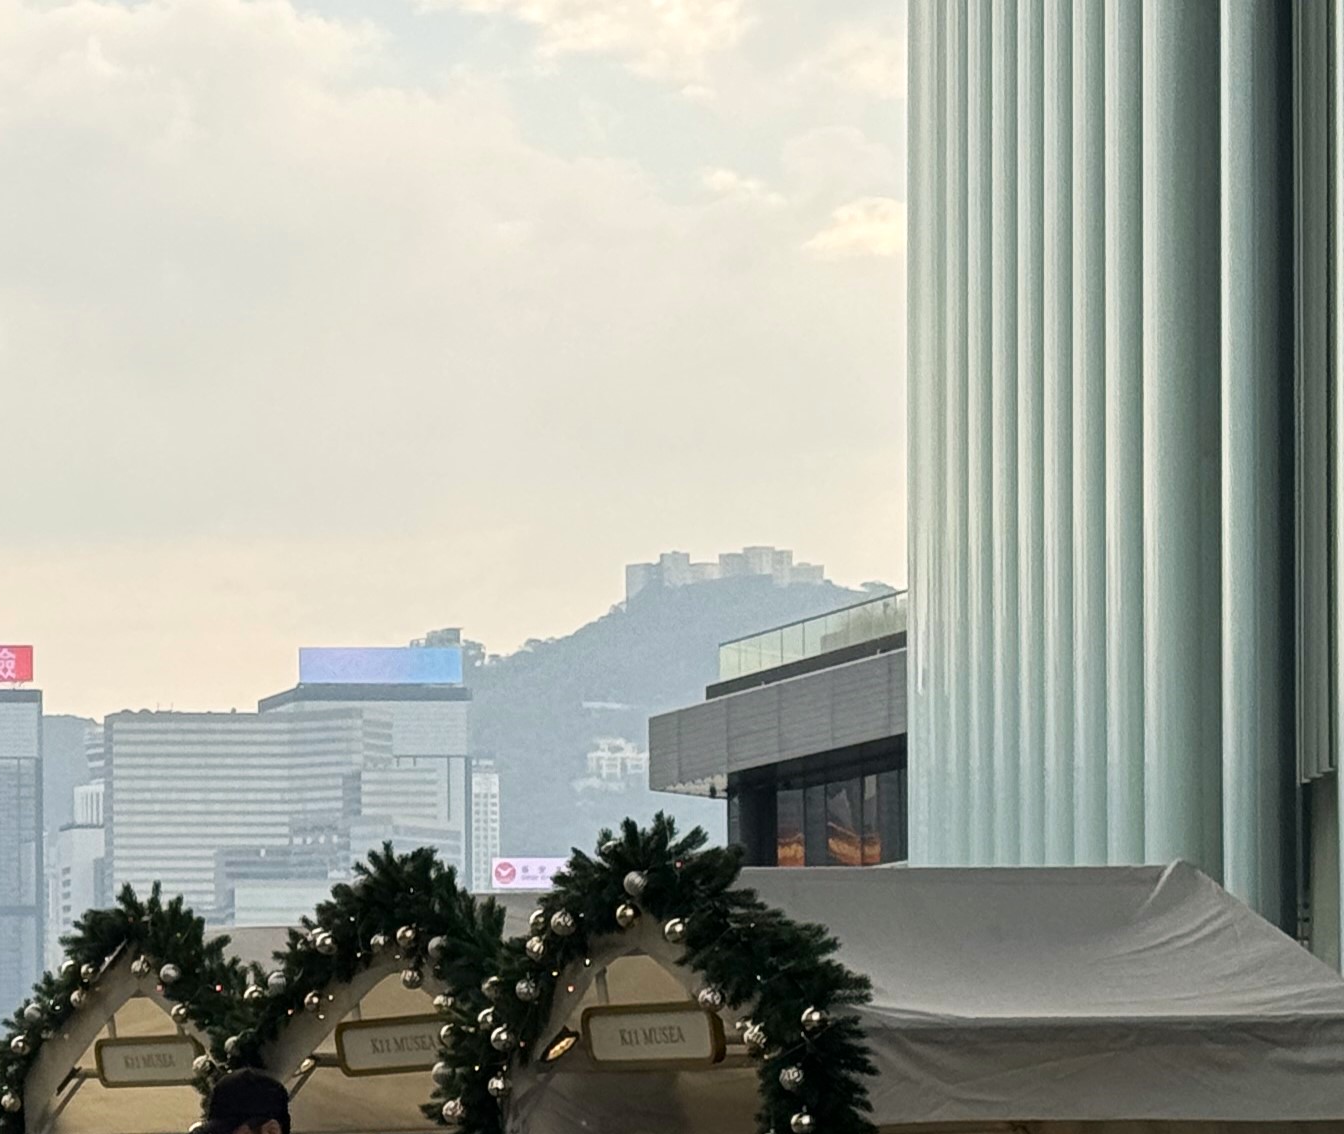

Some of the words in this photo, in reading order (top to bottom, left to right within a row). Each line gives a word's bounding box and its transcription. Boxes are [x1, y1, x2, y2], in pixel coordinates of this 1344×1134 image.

[370, 1038, 393, 1055] K11
[393, 1034, 438, 1054] MUSEA
[618, 1028, 640, 1047] K11
[642, 1026, 686, 1046] MUSEA
